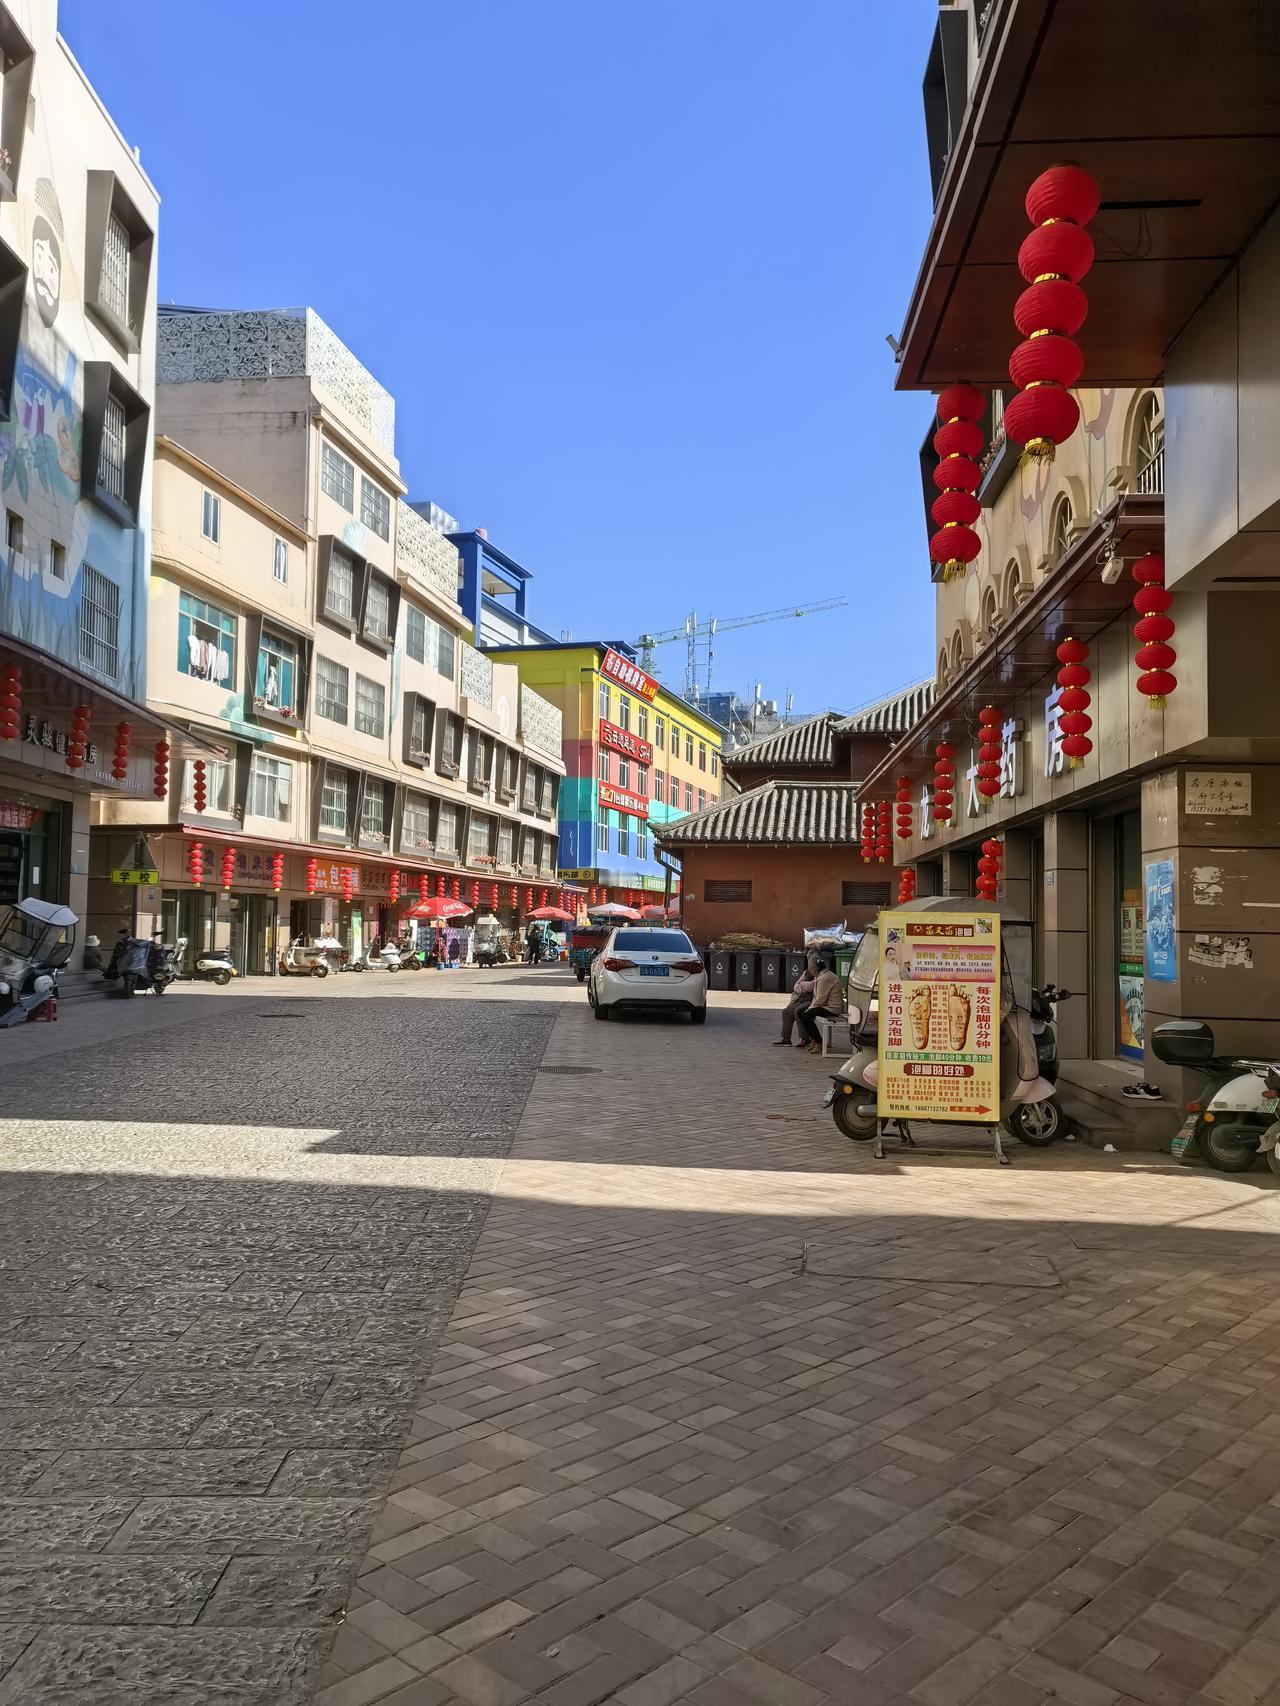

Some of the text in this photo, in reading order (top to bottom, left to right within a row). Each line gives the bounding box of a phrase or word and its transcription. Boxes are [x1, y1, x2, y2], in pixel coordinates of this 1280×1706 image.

[119, 872, 151, 883] 学校
[887, 983, 903, 1047] 进店10元泡脚
[976, 986, 991, 1049] 每次泡脚40分钟
[911, 1064, 965, 1076] 泡脚的好处
